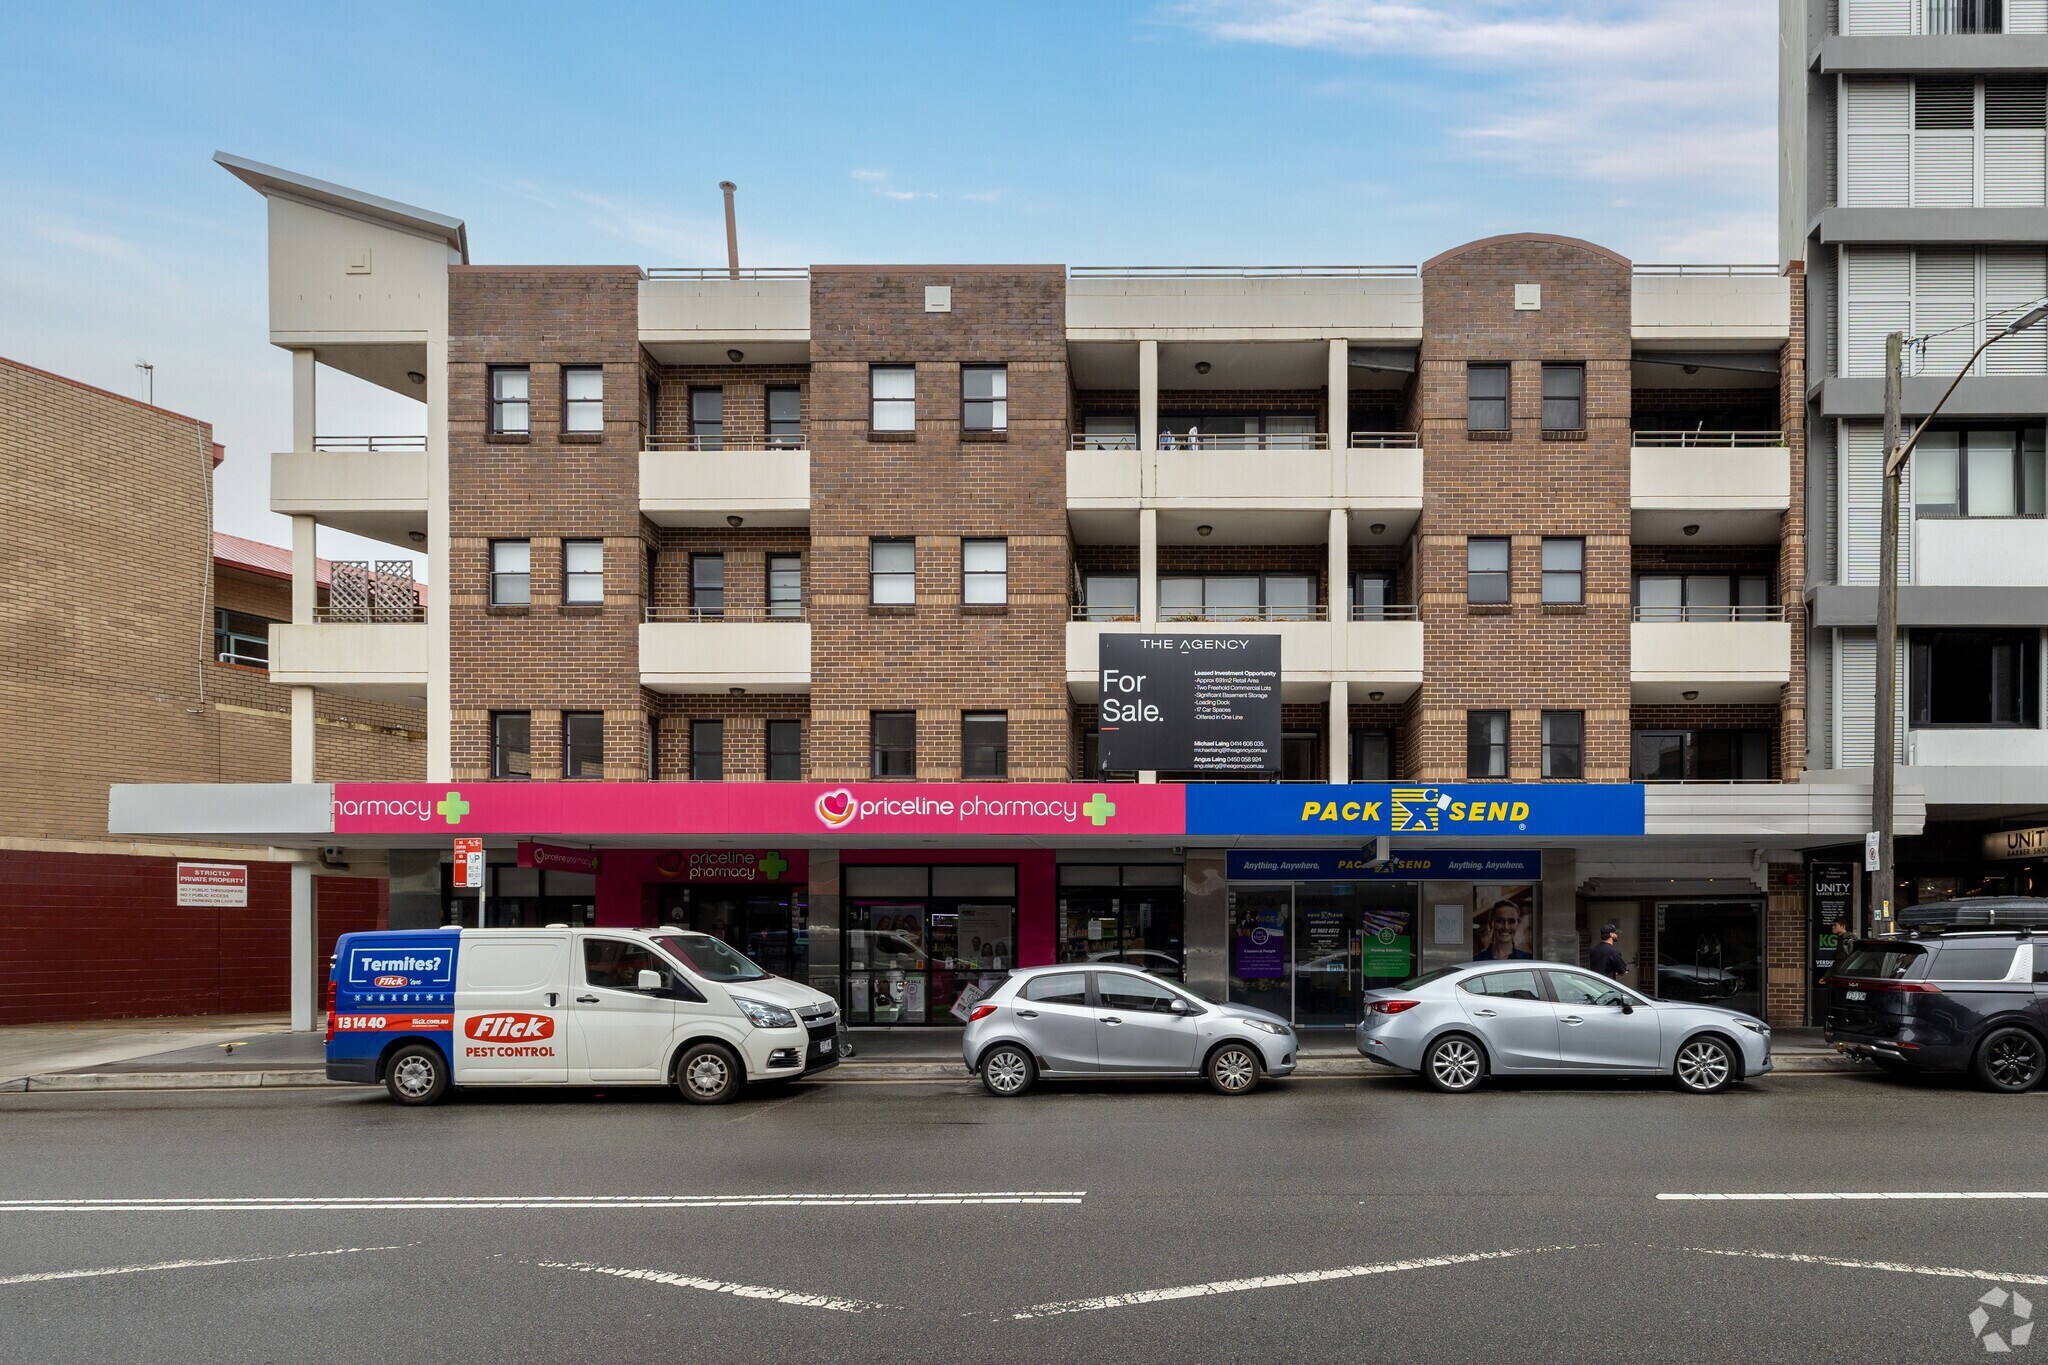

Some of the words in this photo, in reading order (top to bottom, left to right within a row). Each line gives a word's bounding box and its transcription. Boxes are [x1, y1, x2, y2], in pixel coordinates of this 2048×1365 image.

[1140, 639, 1173, 649] THE
[1180, 640, 1250, 652] AGENCY
[1103, 670, 1146, 692] For
[1102, 698, 1164, 722] Sale.
[860, 796, 954, 820] priceline
[960, 795, 1077, 822] pharmacy
[1302, 802, 1383, 821] PACK
[1448, 802, 1530, 821] SEND
[690, 851, 754, 866] priceline
[1338, 861, 1362, 869] PAC
[1398, 860, 1431, 869] SEND
[1448, 861, 1484, 870] Anything.
[1485, 861, 1525, 870] Anywhere.
[690, 866, 755, 880] pharmacy
[1244, 862, 1279, 870] Anything.
[1280, 862, 1320, 870] Anywhere.
[1820, 934, 1838, 947] KG
[362, 956, 441, 971] Termites?
[378, 978, 404, 986] Flick
[473, 1017, 546, 1037] Flick
[466, 1047, 495, 1057] PEST
[497, 1047, 555, 1057] CONTROL
